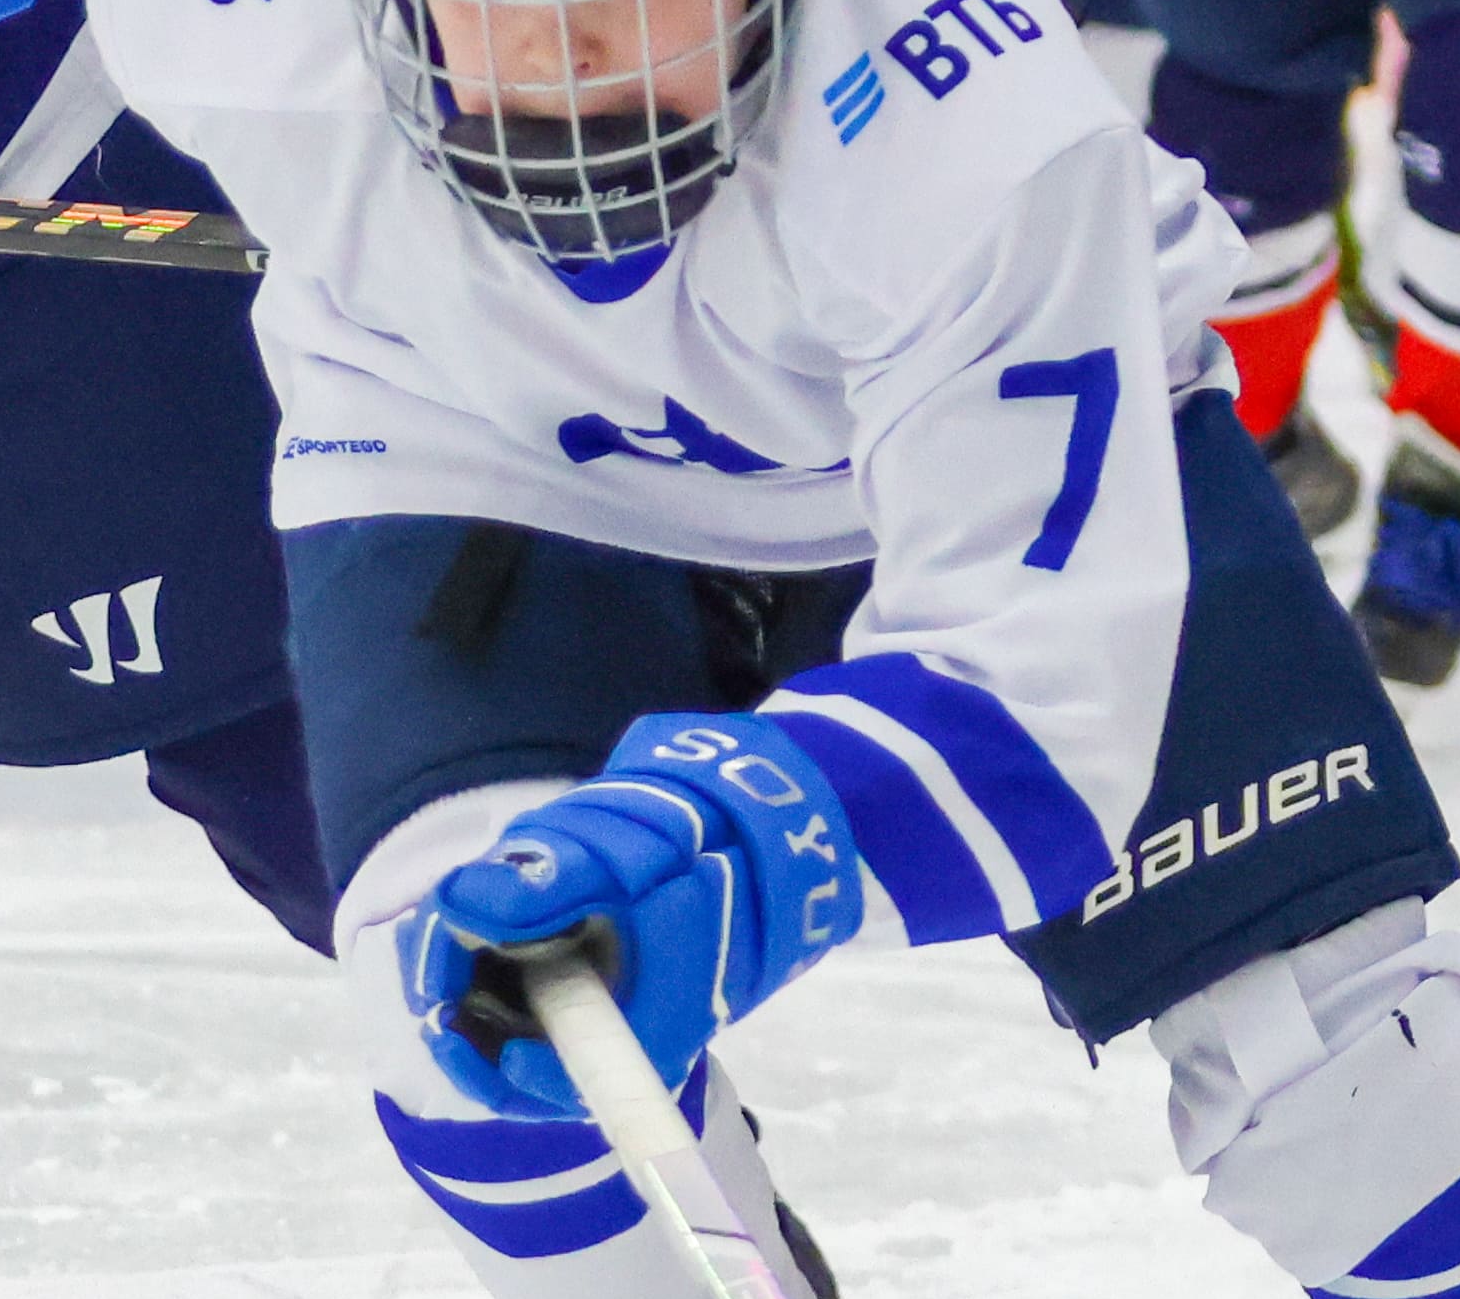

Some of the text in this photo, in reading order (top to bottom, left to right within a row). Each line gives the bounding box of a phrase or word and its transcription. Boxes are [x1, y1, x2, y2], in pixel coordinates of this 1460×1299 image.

[296, 439, 387, 455] SPORTEGO
[998, 347, 1120, 572] 7
[651, 726, 841, 974] SOYU
[1081, 743, 1375, 926] BAUER
